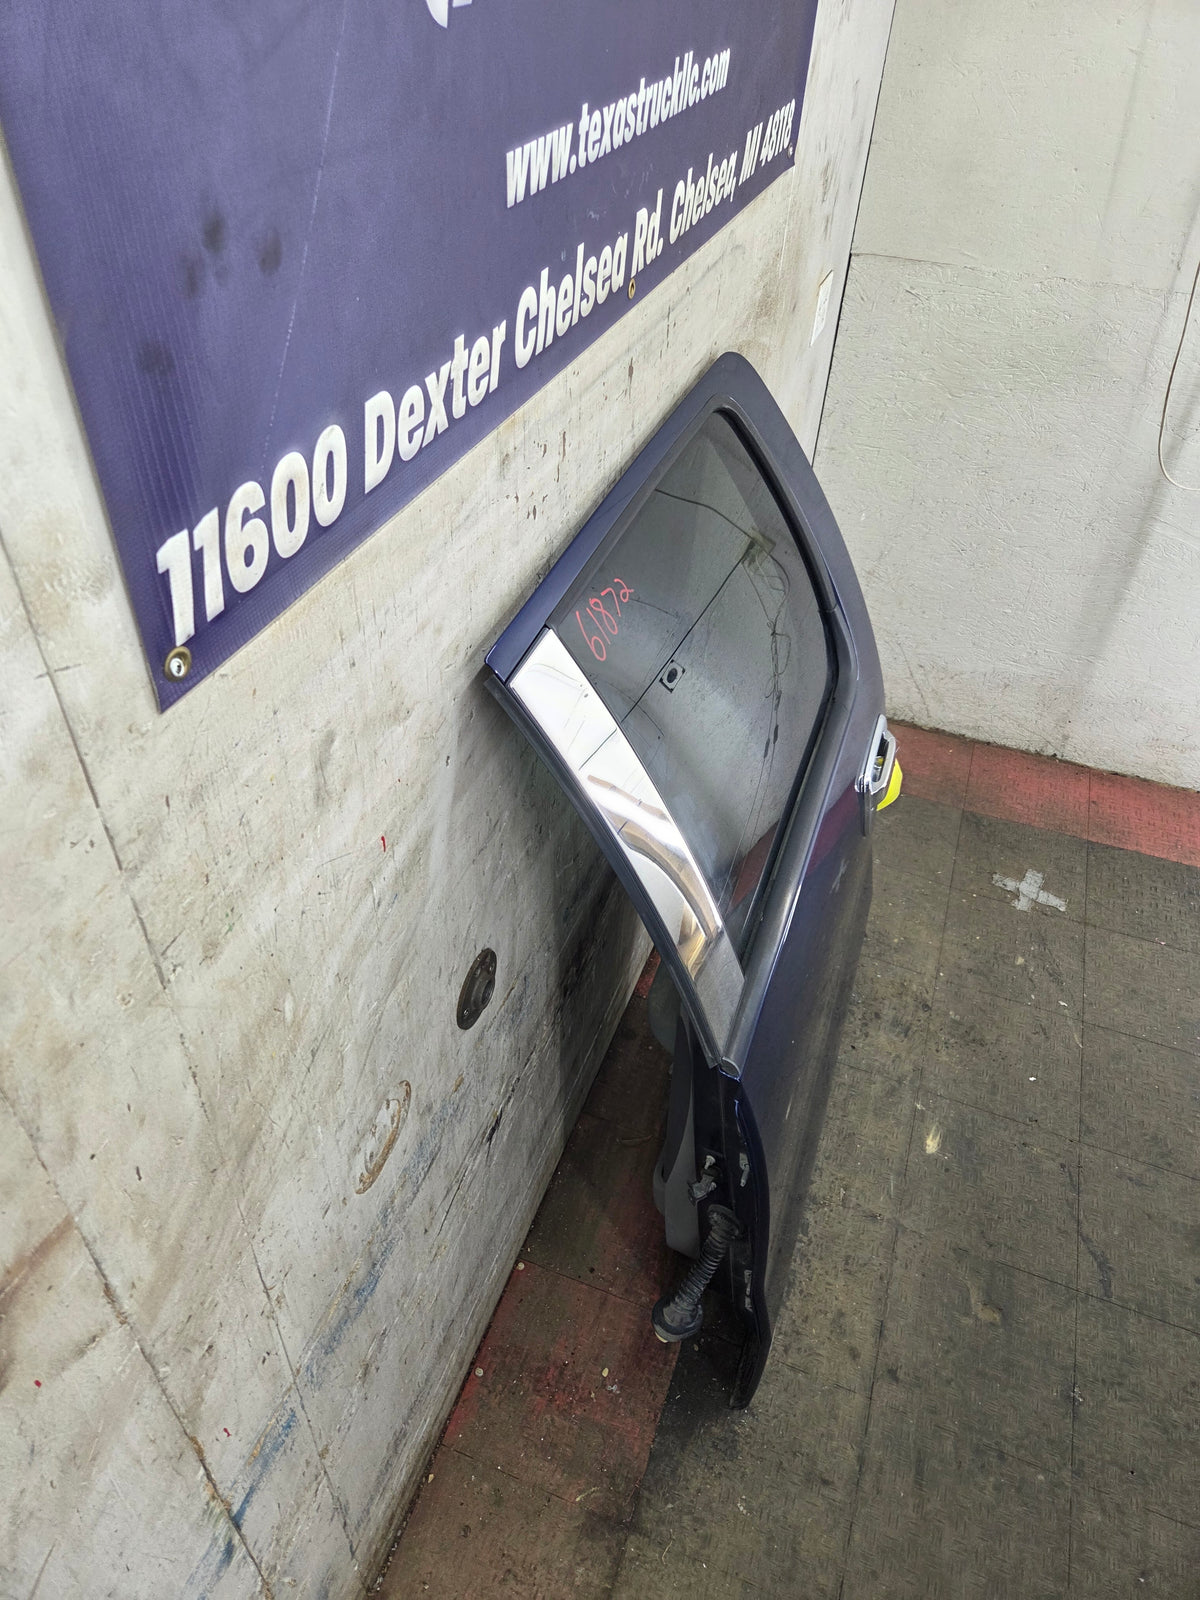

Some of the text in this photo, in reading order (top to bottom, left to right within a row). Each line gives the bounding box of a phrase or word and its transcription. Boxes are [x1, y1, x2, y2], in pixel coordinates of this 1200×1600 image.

[506, 48, 731, 208] www.texastruckllc.com
[156, 99, 796, 647] 11600 Dexter Chelsea Rd. Chelsea, MI 48118
[575, 578, 635, 662] 61872
